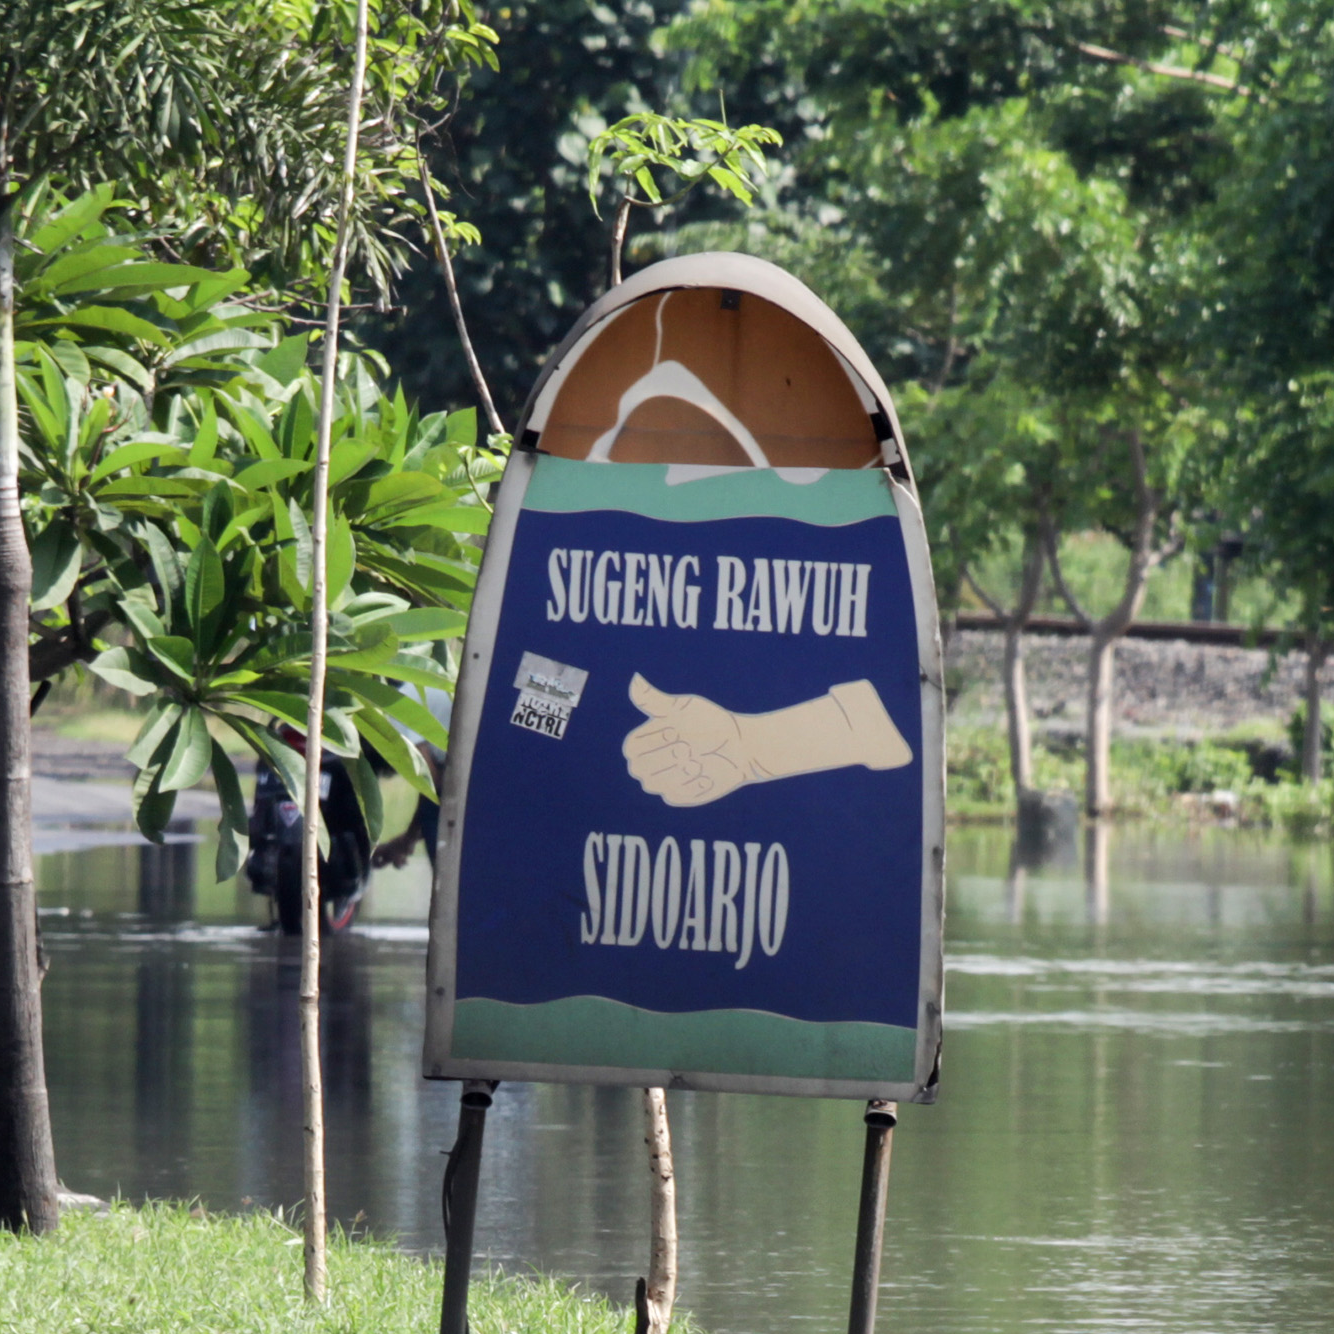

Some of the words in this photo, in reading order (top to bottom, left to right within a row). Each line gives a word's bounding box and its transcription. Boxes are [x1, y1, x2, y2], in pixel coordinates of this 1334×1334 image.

[547, 548, 701, 629] SUGENG
[713, 556, 871, 637] RAWUH
[581, 831, 789, 970] SIDOARJO
